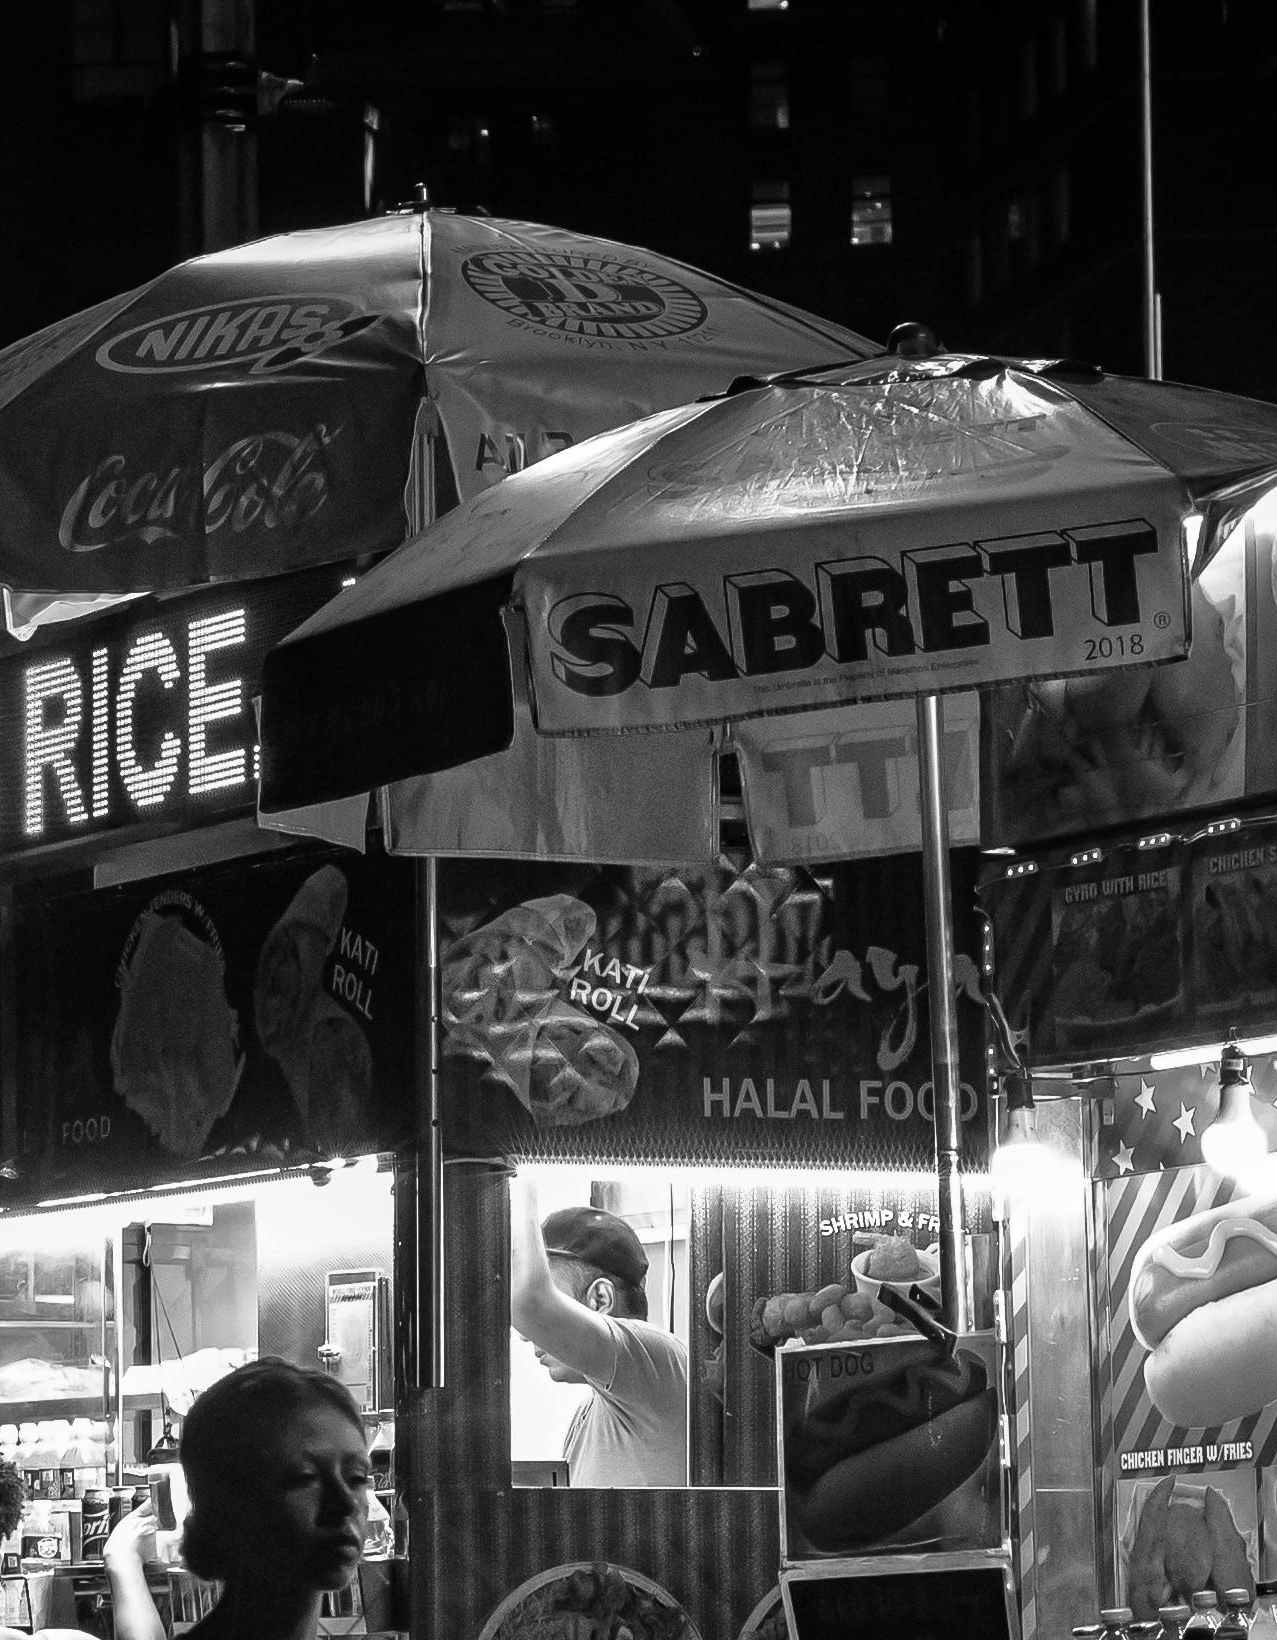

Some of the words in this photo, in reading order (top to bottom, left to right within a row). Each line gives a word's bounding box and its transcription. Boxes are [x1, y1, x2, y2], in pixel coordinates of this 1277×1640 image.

[136, 301, 333, 362] NIKAS
[548, 517, 1159, 697] SABRETT
[1083, 634, 1145, 661] 2018
[25, 608, 246, 834] RICE
[1209, 852, 1266, 874] CHICKEN
[1064, 881, 1098, 903] GYRO
[1101, 876, 1135, 896] WITH
[1137, 870, 1168, 890] RICE
[339, 925, 380, 977] KATI
[582, 948, 651, 996] KATI
[331, 964, 374, 1021] ROLL
[569, 979, 641, 1033] ROLL
[702, 1076, 845, 1120] HALAL
[61, 1114, 112, 1145] FOOD
[820, 1209, 894, 1237] SHRIMP
[896, 1209, 916, 1229] &
[917, 1213, 940, 1234] FR
[829, 1351, 875, 1379] DOG
[1120, 1449, 1165, 1471] CHICKEN
[1167, 1445, 1203, 1465] FINGER
